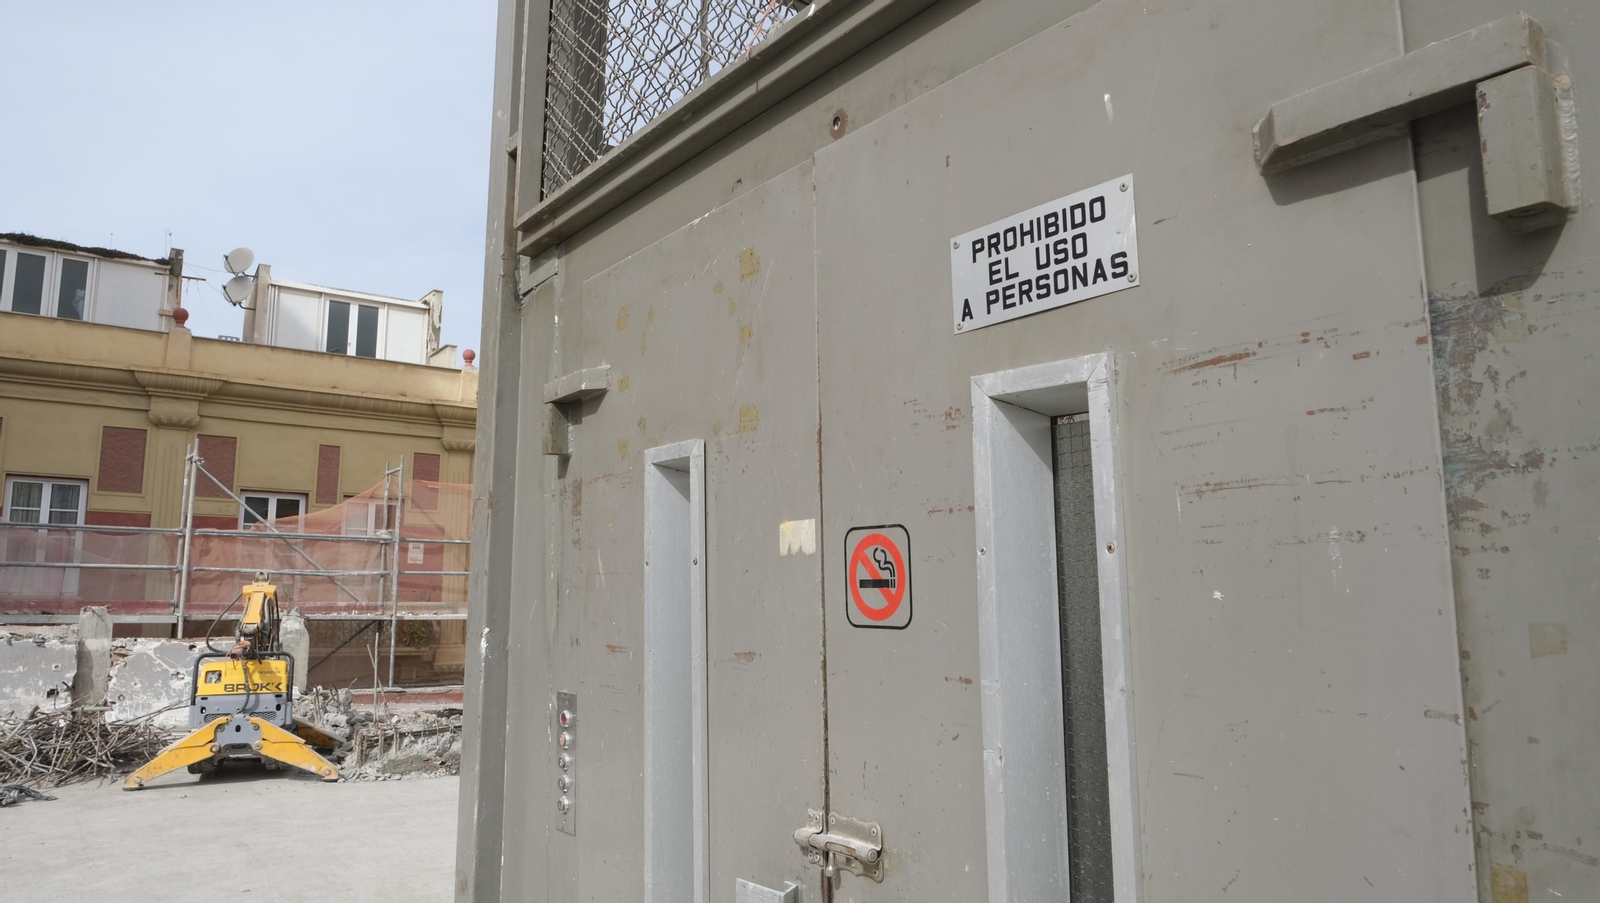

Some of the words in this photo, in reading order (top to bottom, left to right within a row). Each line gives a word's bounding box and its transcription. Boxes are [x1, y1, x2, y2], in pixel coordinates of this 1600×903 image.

[971, 195, 1106, 264] PROHIBIDO
[988, 257, 1020, 286] EL
[1035, 232, 1088, 271] USO
[961, 298, 974, 322] A
[985, 251, 1129, 315] PERSONAS
